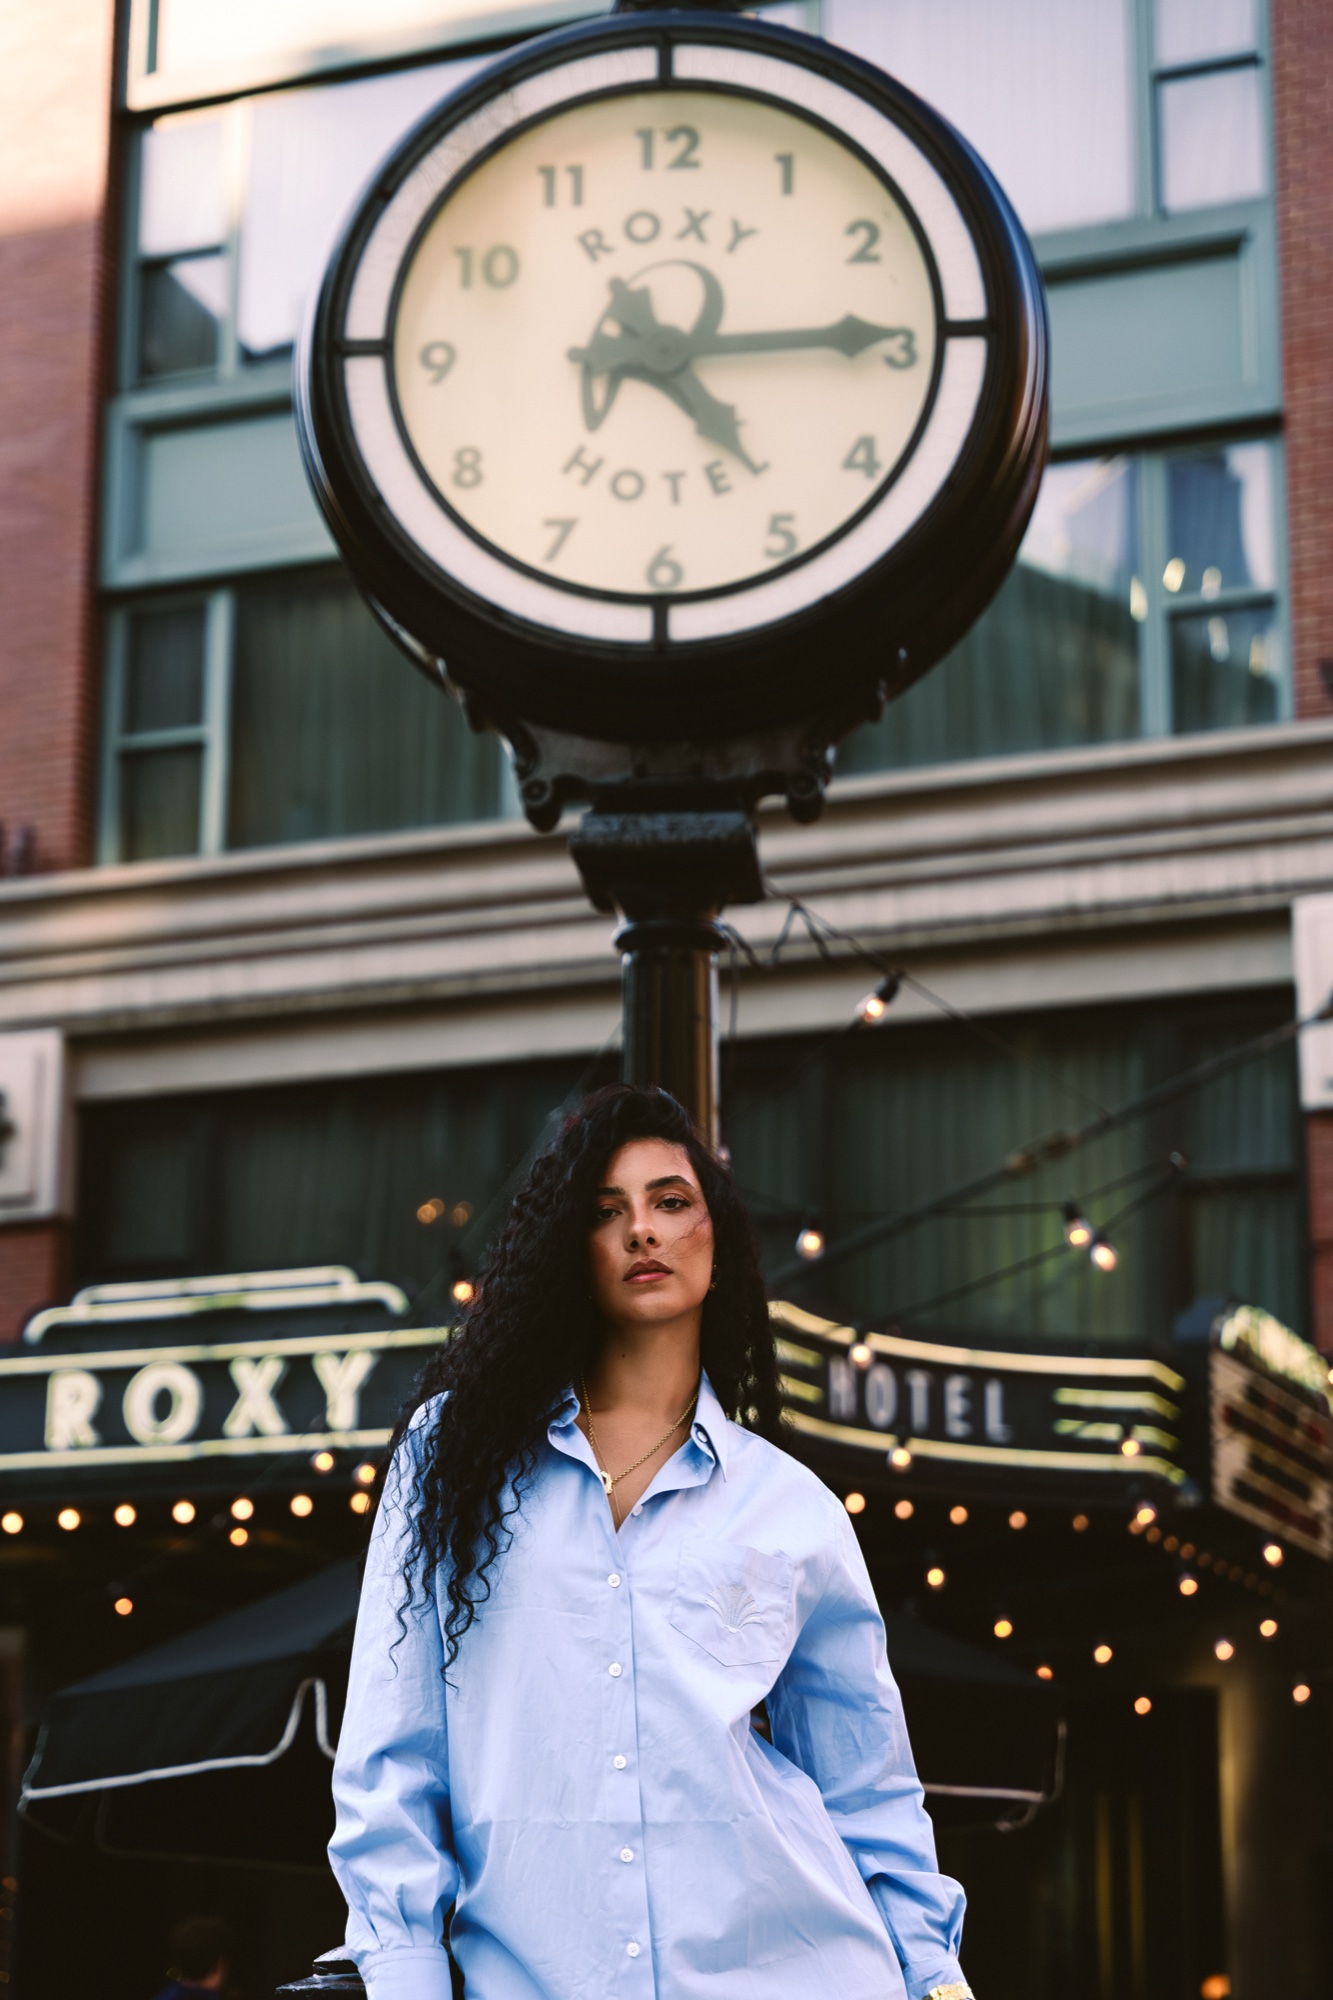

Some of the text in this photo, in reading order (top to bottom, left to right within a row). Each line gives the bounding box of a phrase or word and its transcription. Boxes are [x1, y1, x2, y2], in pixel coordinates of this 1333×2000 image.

[635, 126, 701, 170] 12
[538, 165, 585, 208] 11
[775, 153, 795, 196] 1
[577, 208, 758, 264] ROXY
[846, 219, 881, 264] 2
[453, 244, 519, 289] 10
[419, 340, 457, 384] 9
[884, 326, 918, 370] 3
[452, 446, 484, 489] 8
[561, 444, 771, 505] HOTEL
[842, 435, 881, 480] 4
[542, 518, 578, 562] 7
[764, 513, 798, 558] 5
[646, 545, 684, 593] 6
[44, 1350, 376, 1450] ROXY
[828, 1356, 1012, 1442] HOTEL
